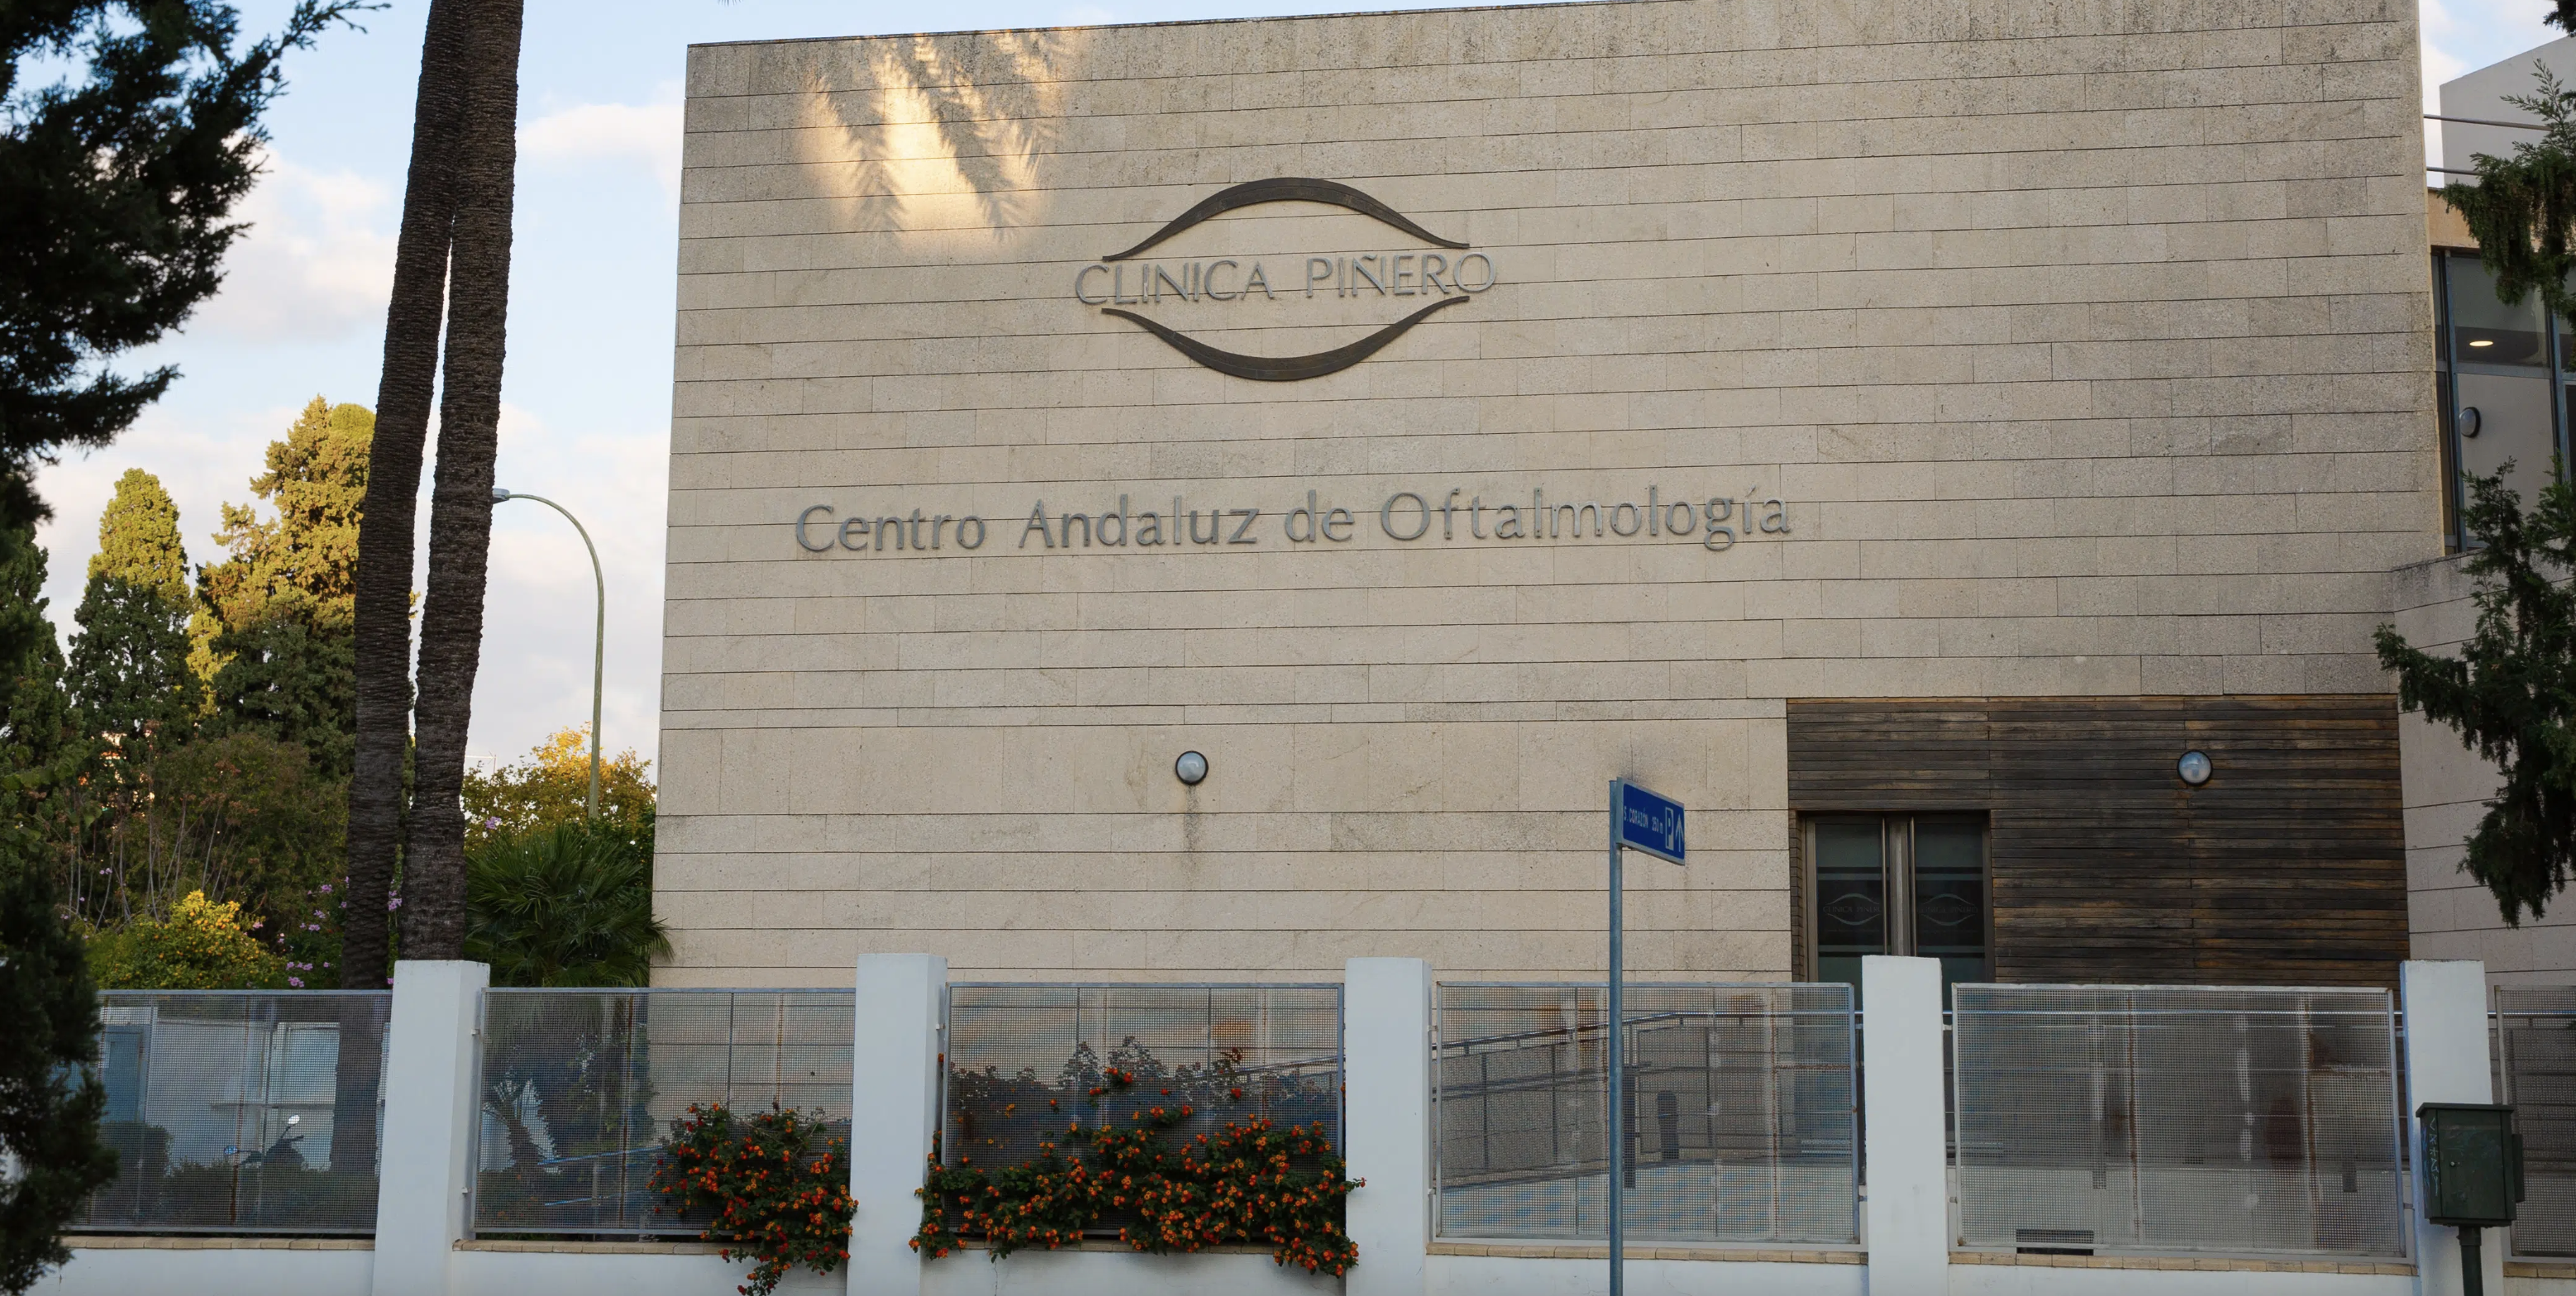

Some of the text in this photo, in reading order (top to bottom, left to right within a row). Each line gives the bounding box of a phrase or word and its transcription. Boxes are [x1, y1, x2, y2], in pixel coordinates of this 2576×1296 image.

[1076, 251, 1497, 306] CLINICA PIÑERO
[796, 484, 1791, 551] Centro Andaluz de Oftalmología
